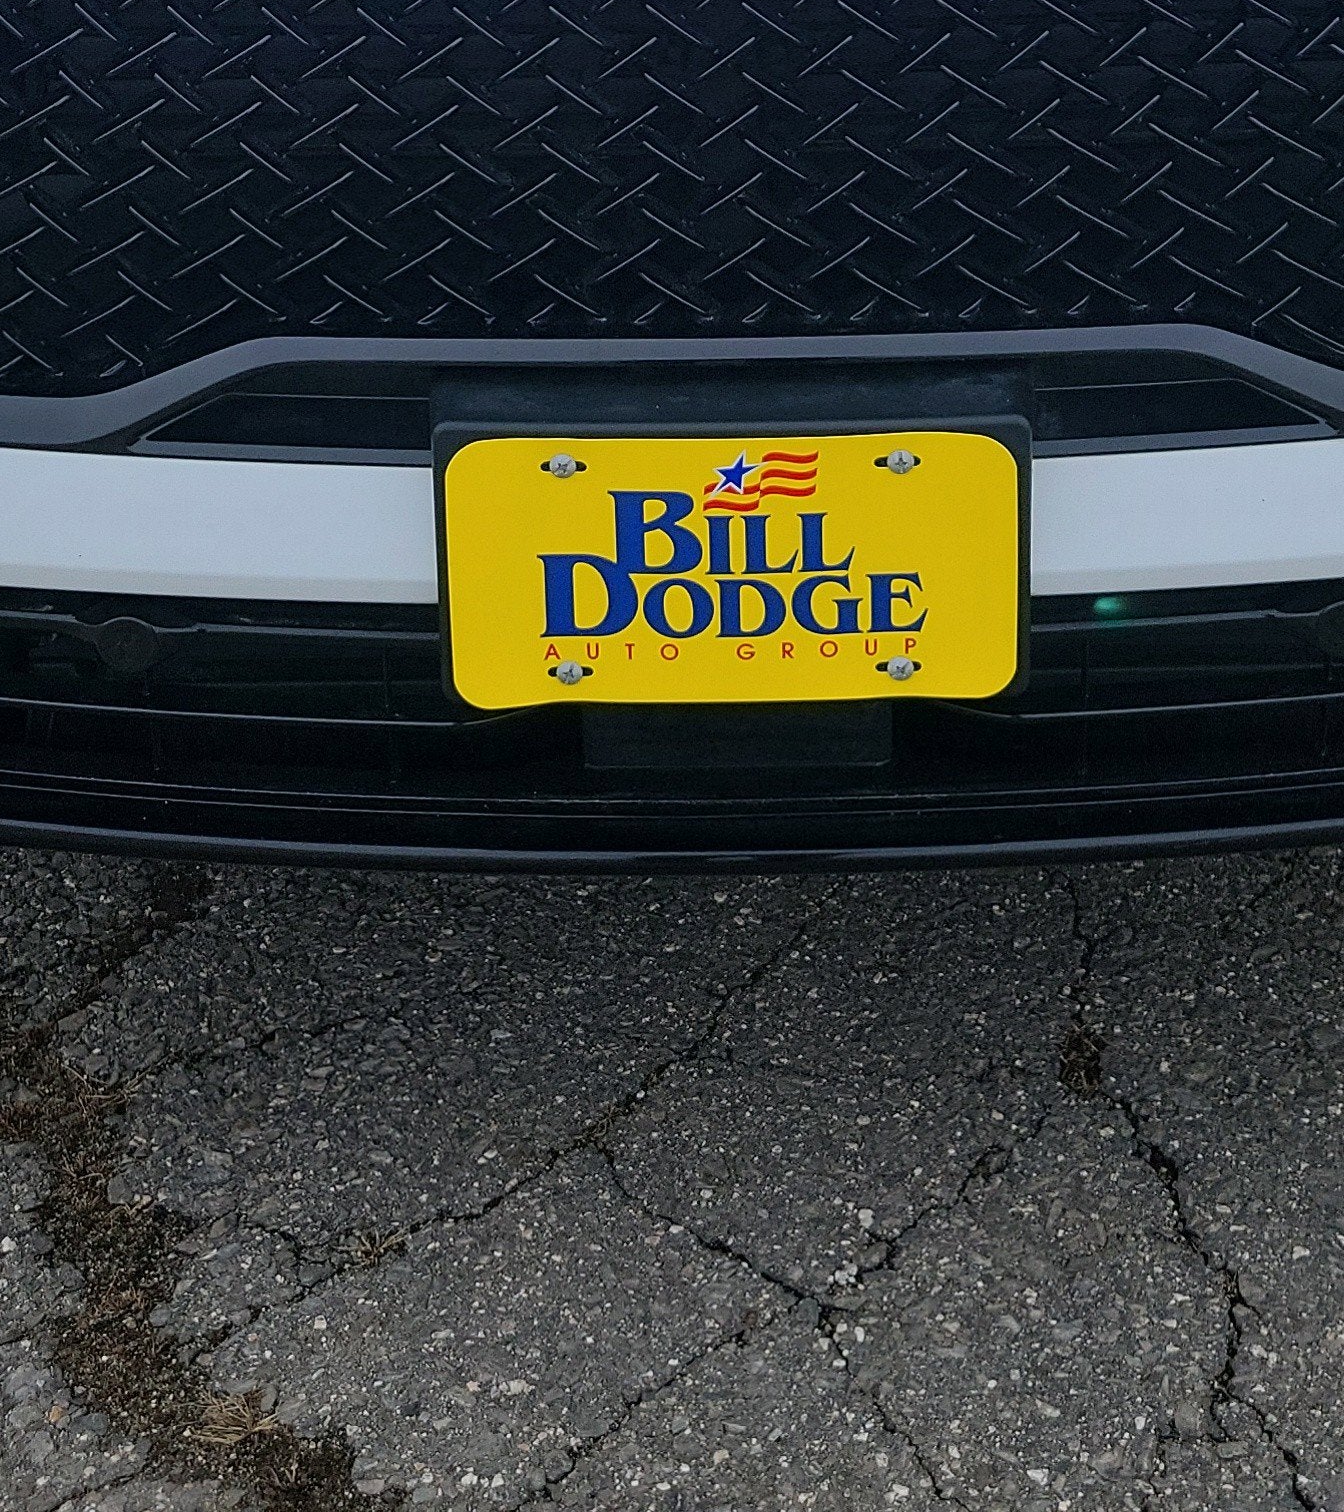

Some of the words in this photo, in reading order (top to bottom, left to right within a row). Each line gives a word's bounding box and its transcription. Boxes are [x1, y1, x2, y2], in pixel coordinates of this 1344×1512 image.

[607, 490, 856, 575] BILL
[536, 553, 928, 639] DODGE
[544, 642, 681, 662] AUTO
[736, 637, 918, 661] GROUP
